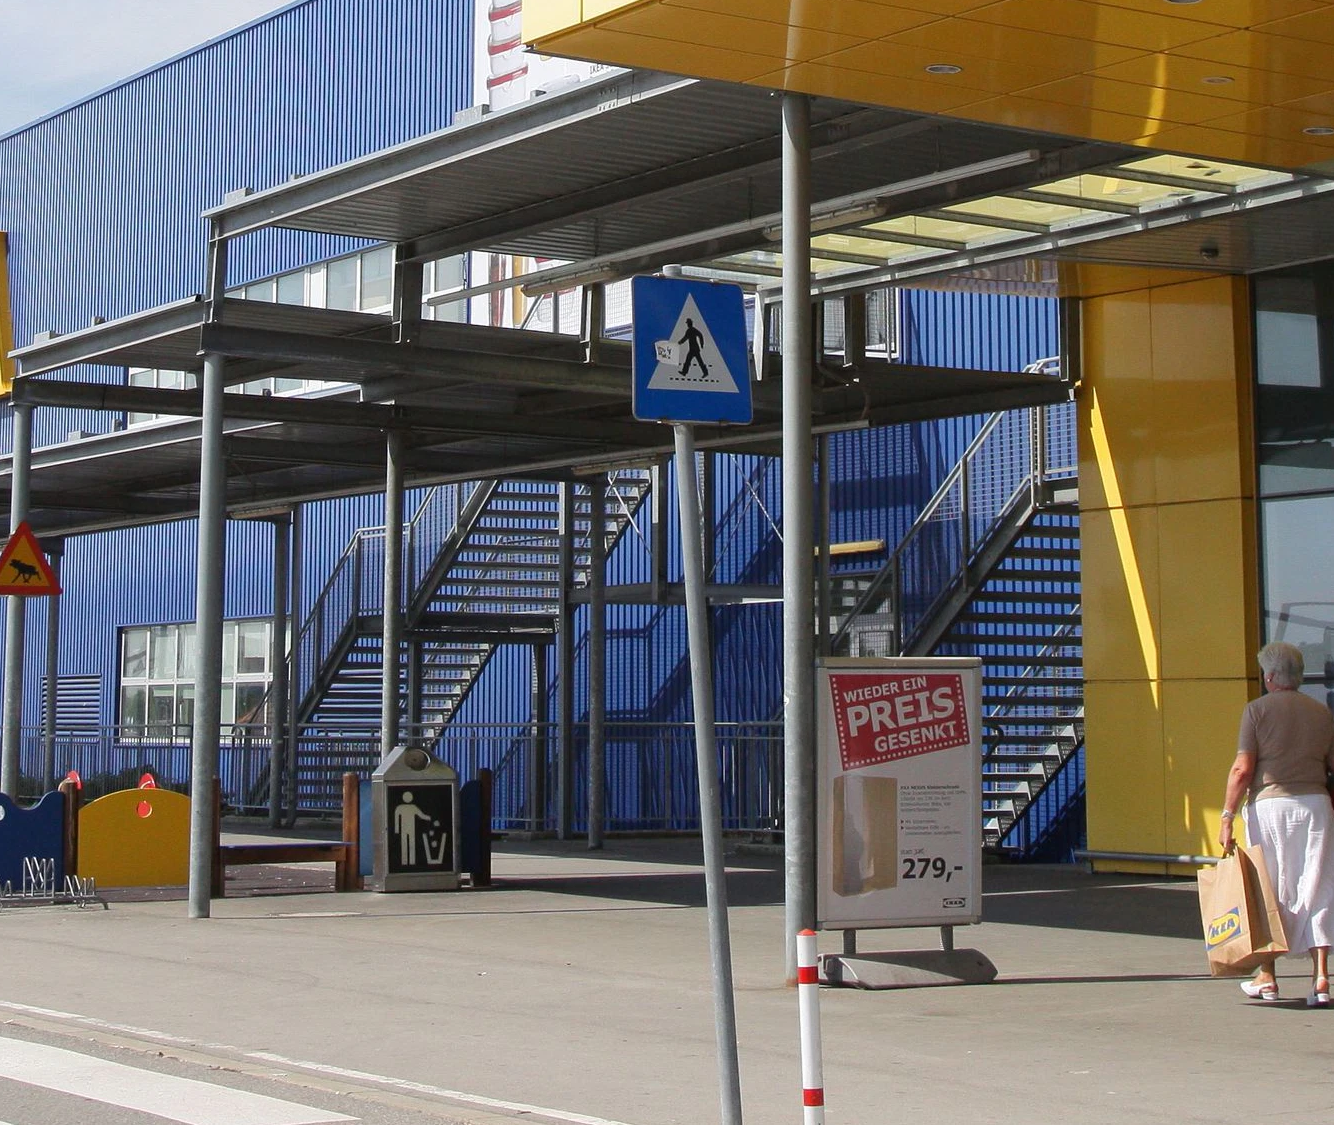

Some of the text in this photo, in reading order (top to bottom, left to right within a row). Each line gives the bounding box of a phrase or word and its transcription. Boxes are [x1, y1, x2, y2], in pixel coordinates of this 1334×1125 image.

[843, 676, 927, 703] WIEDER EIN
[847, 687, 955, 737] PREIS
[874, 720, 956, 752] GESENKT
[902, 857, 964, 883] 279,-
